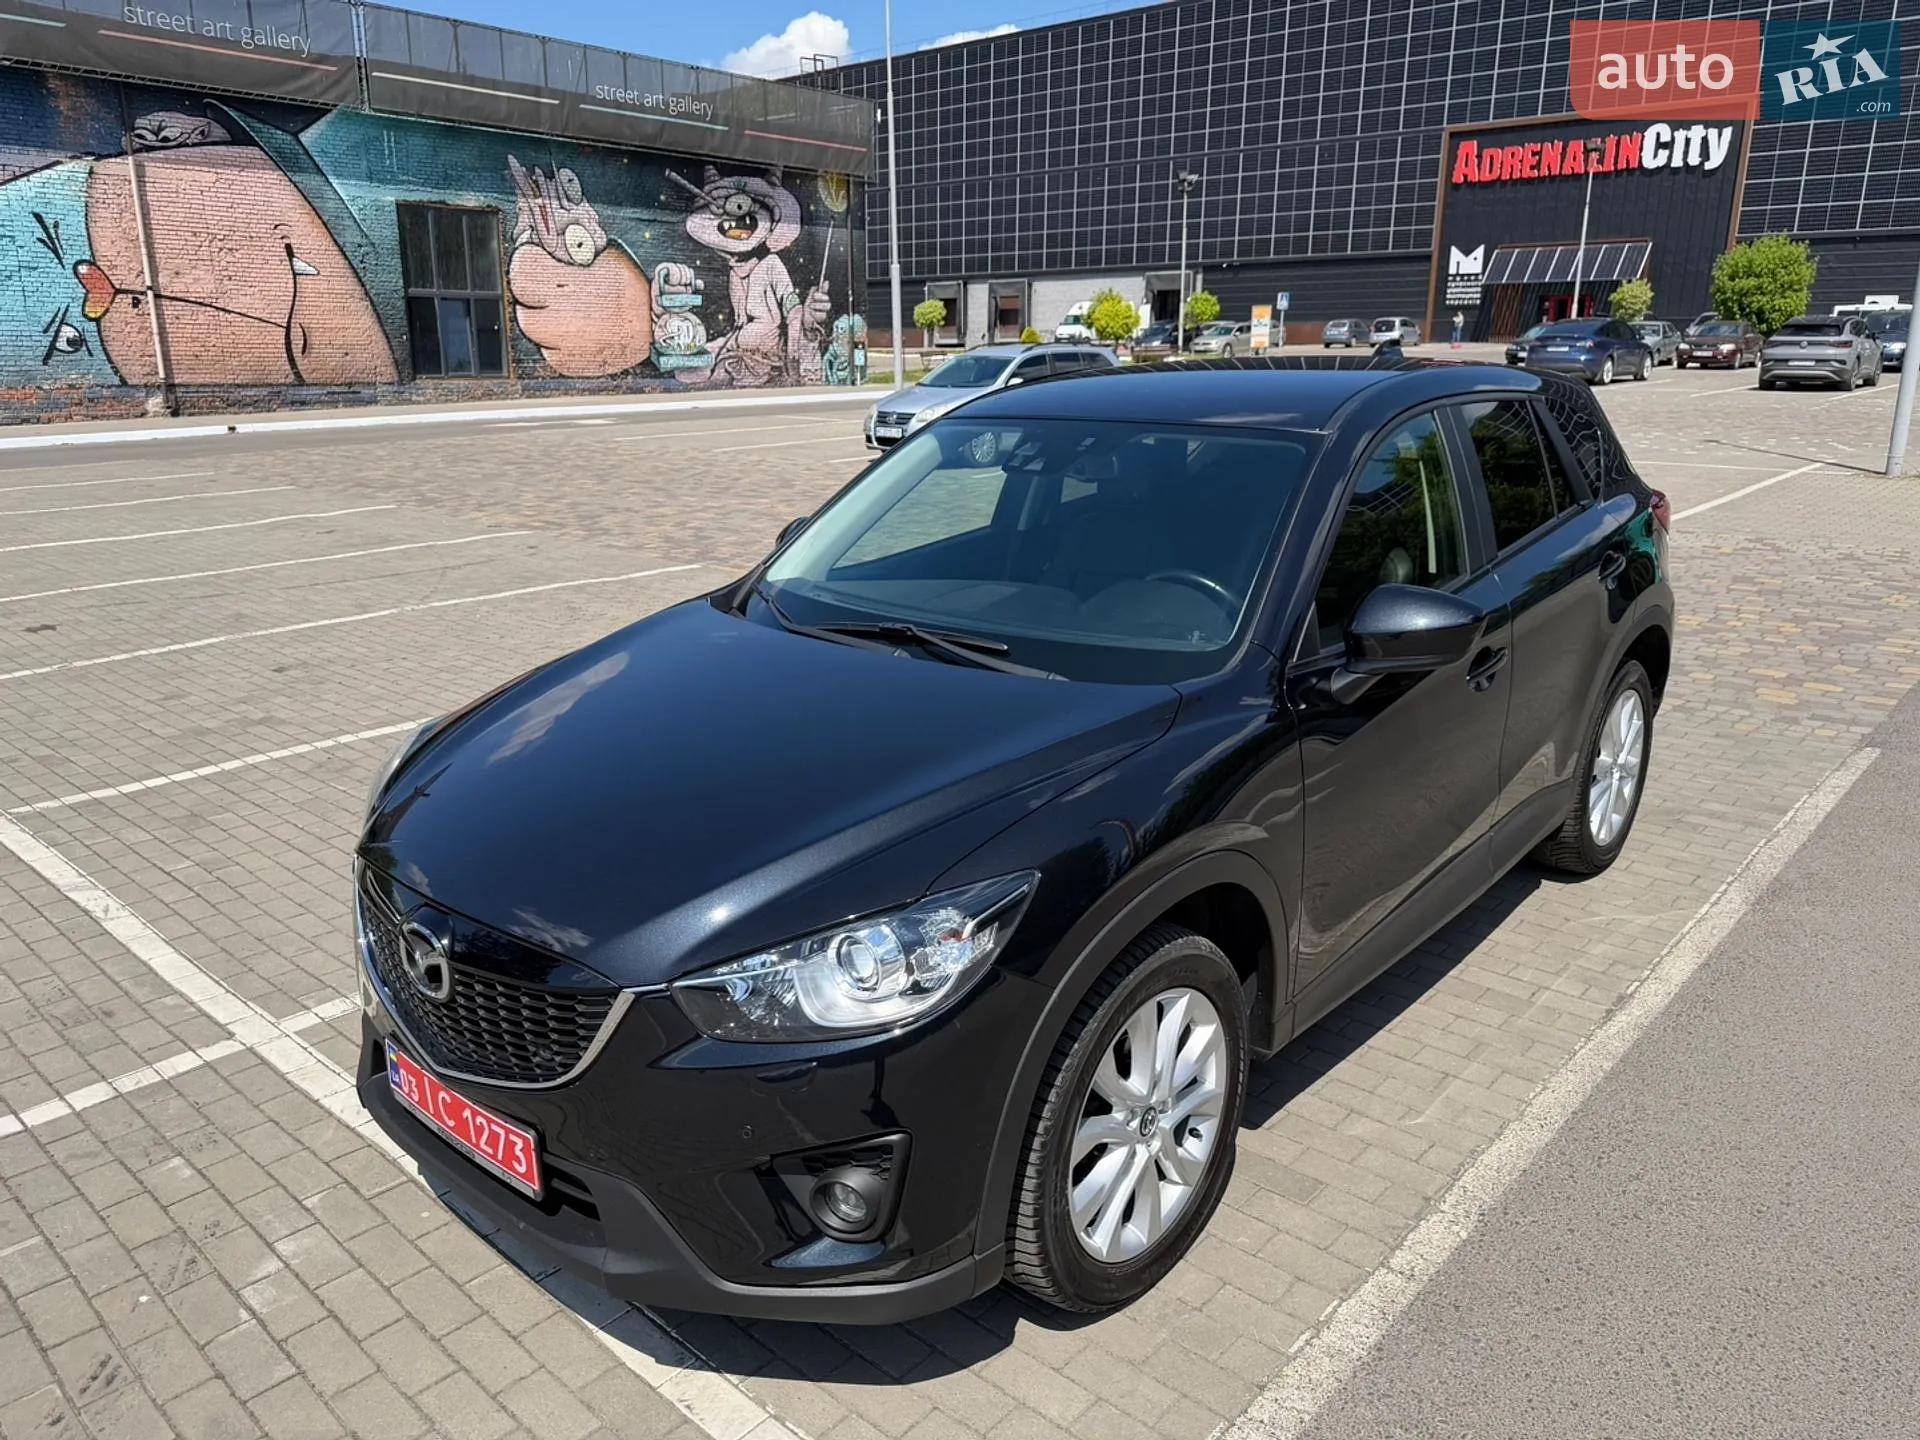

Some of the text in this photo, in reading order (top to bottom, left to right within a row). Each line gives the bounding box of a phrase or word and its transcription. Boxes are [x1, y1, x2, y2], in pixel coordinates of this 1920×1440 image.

[122, 6, 312, 58] street art gallery
[595, 84, 714, 121] street art gallery
[400, 1067, 419, 1102] 03
[423, 1075, 456, 1127] IC
[462, 1107, 527, 1174] 1273
